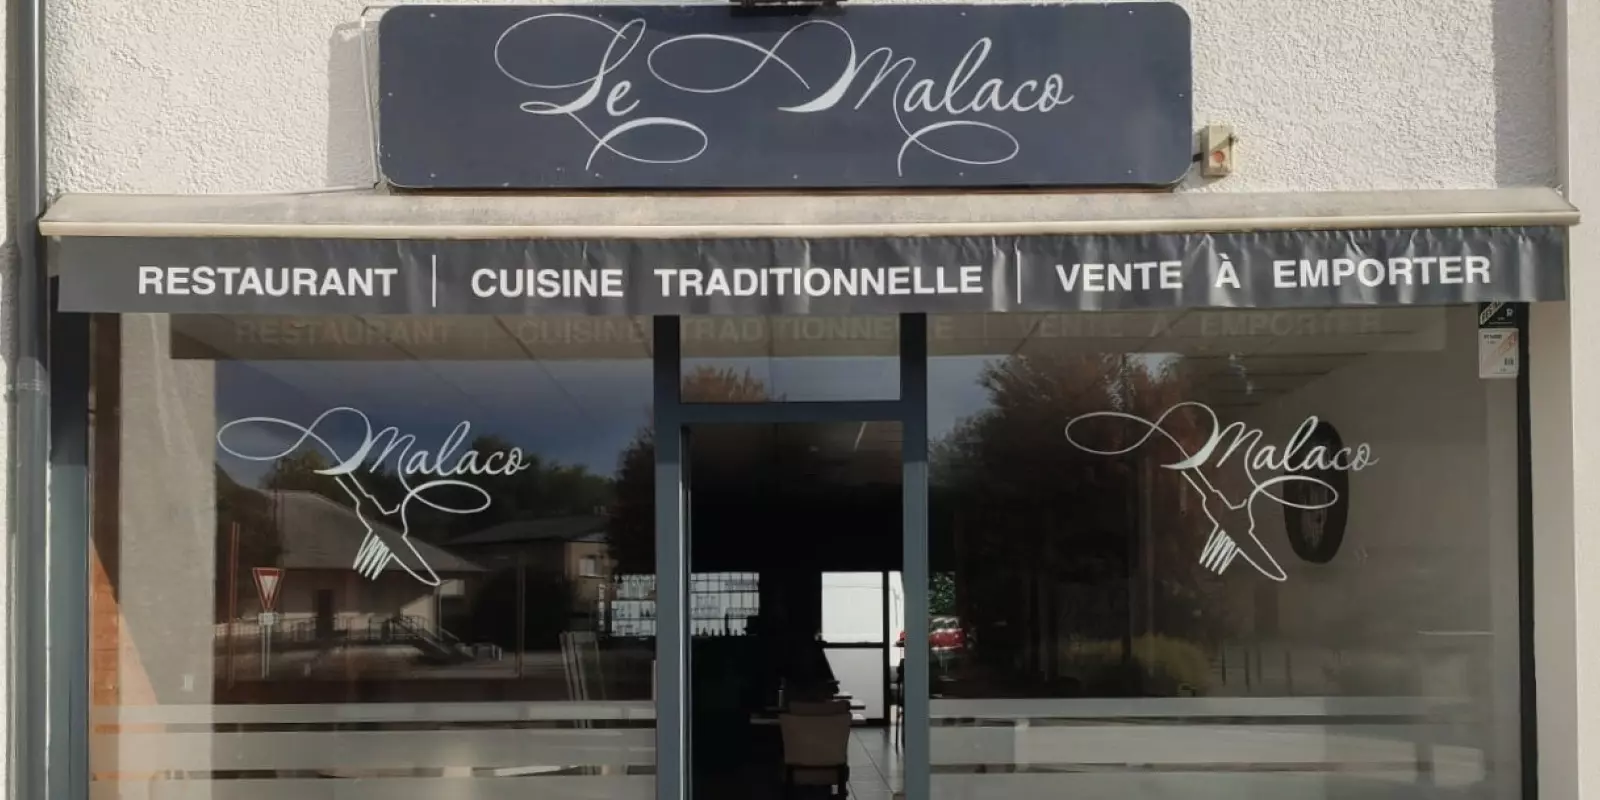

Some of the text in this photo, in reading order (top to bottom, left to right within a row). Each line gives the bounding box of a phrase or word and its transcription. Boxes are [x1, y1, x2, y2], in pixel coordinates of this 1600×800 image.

[647, 20, 1074, 176] Malaco
[137, 265, 399, 298] RESTAURANT
[470, 265, 984, 299] CUISINE TRADITIONNELLE
[1055, 253, 1492, 292] VENTE À EMPORTER
[217, 407, 531, 514] Malaco
[1065, 402, 1380, 509] Malaco
